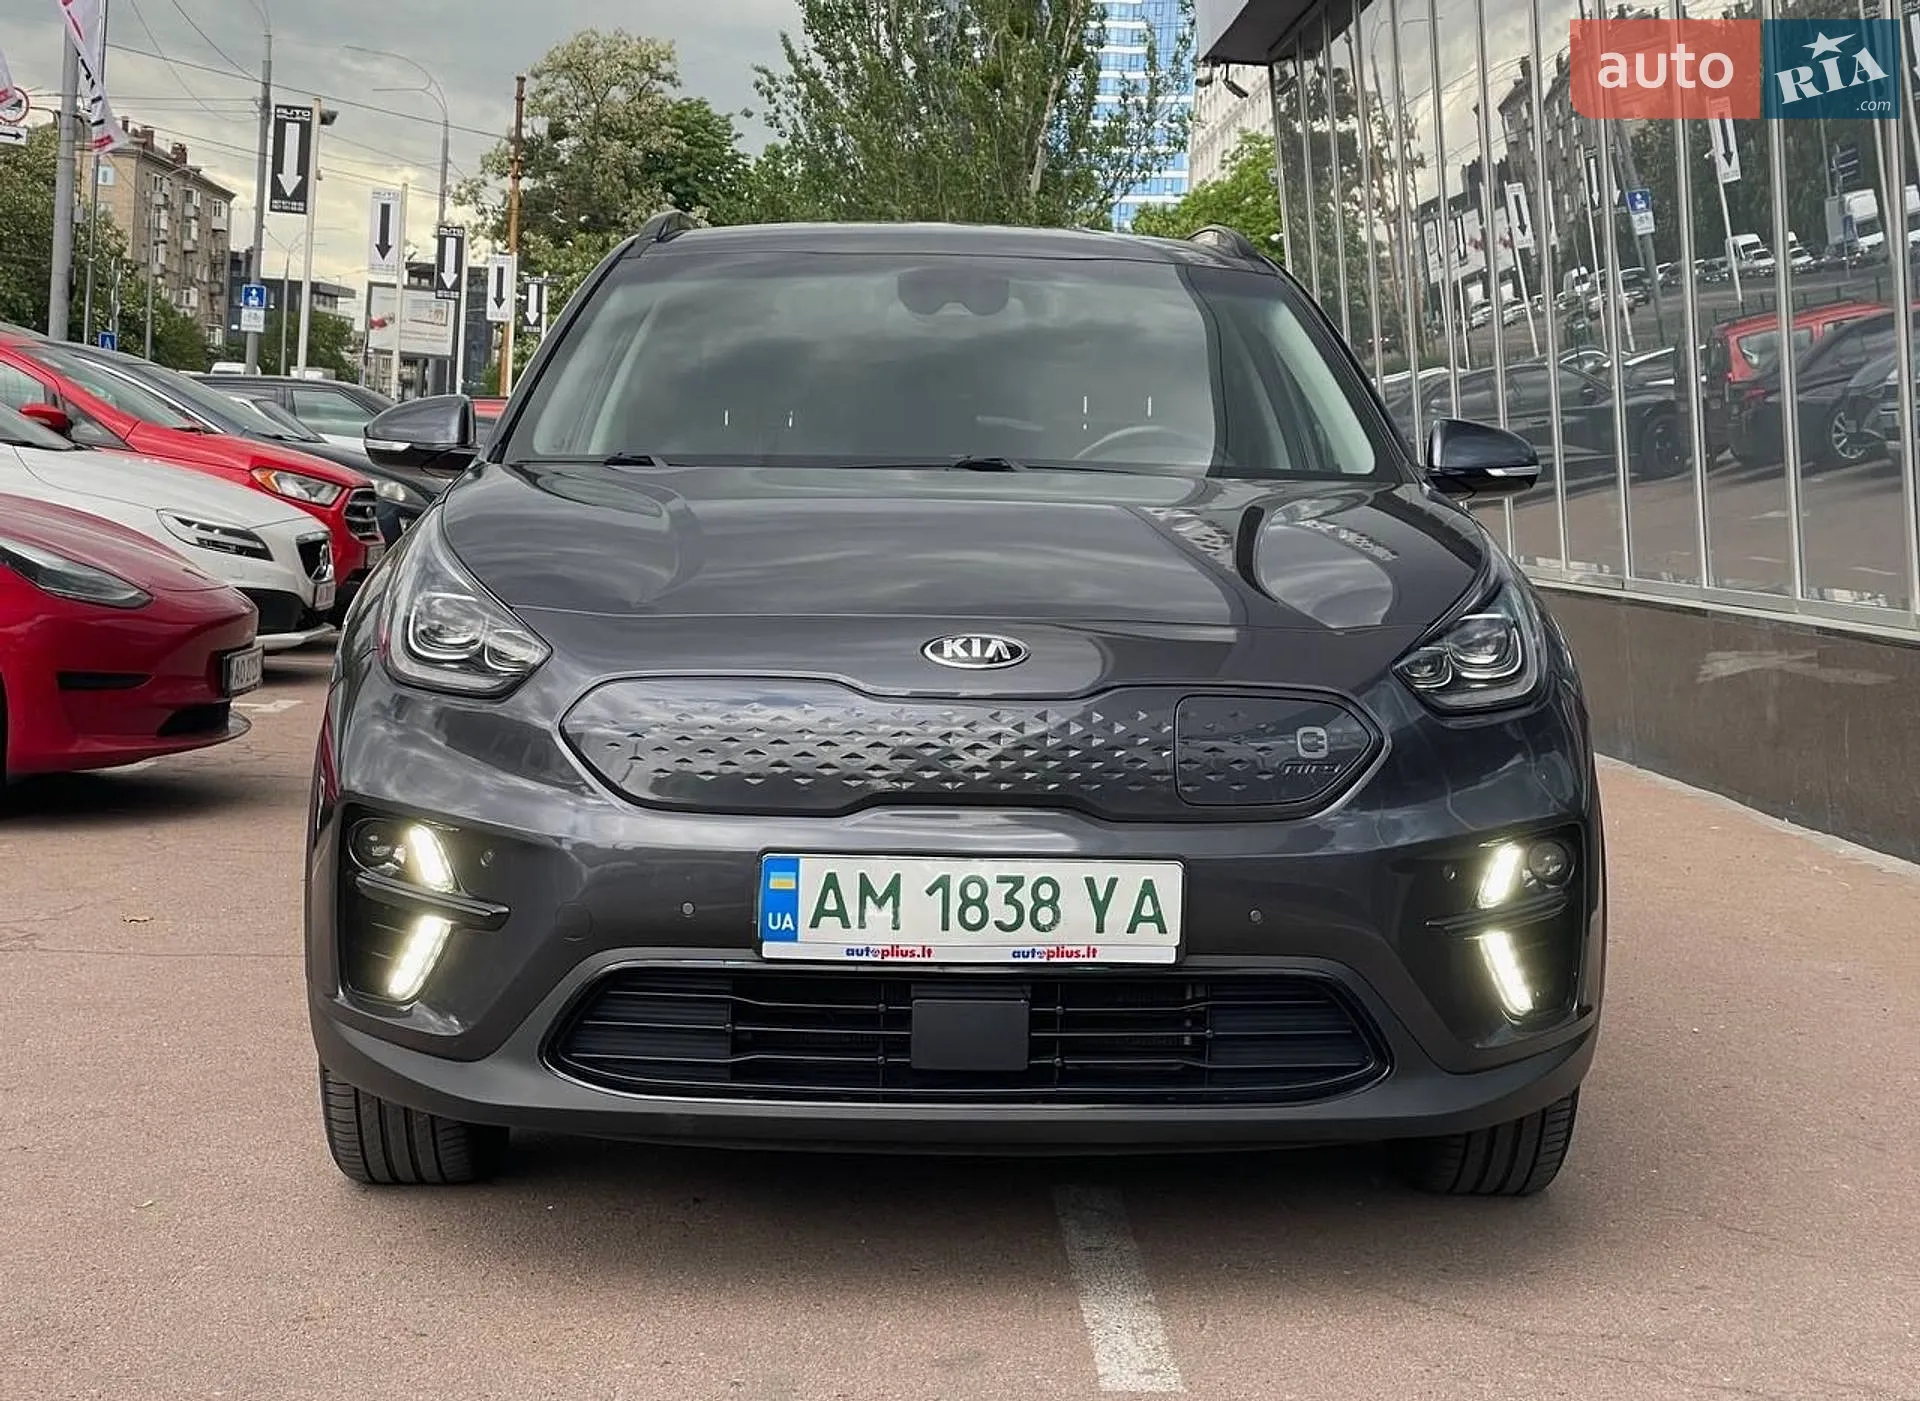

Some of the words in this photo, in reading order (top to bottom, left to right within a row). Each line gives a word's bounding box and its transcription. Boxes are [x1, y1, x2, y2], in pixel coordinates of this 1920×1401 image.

[943, 638, 1011, 660] KIA
[809, 872, 901, 931] AM
[925, 874, 1061, 933] 1838
[1084, 876, 1168, 935] YA
[768, 912, 795, 931] UA
[845, 944, 933, 960] autoplius.lt
[1012, 945, 1098, 961] autoplius.lt
